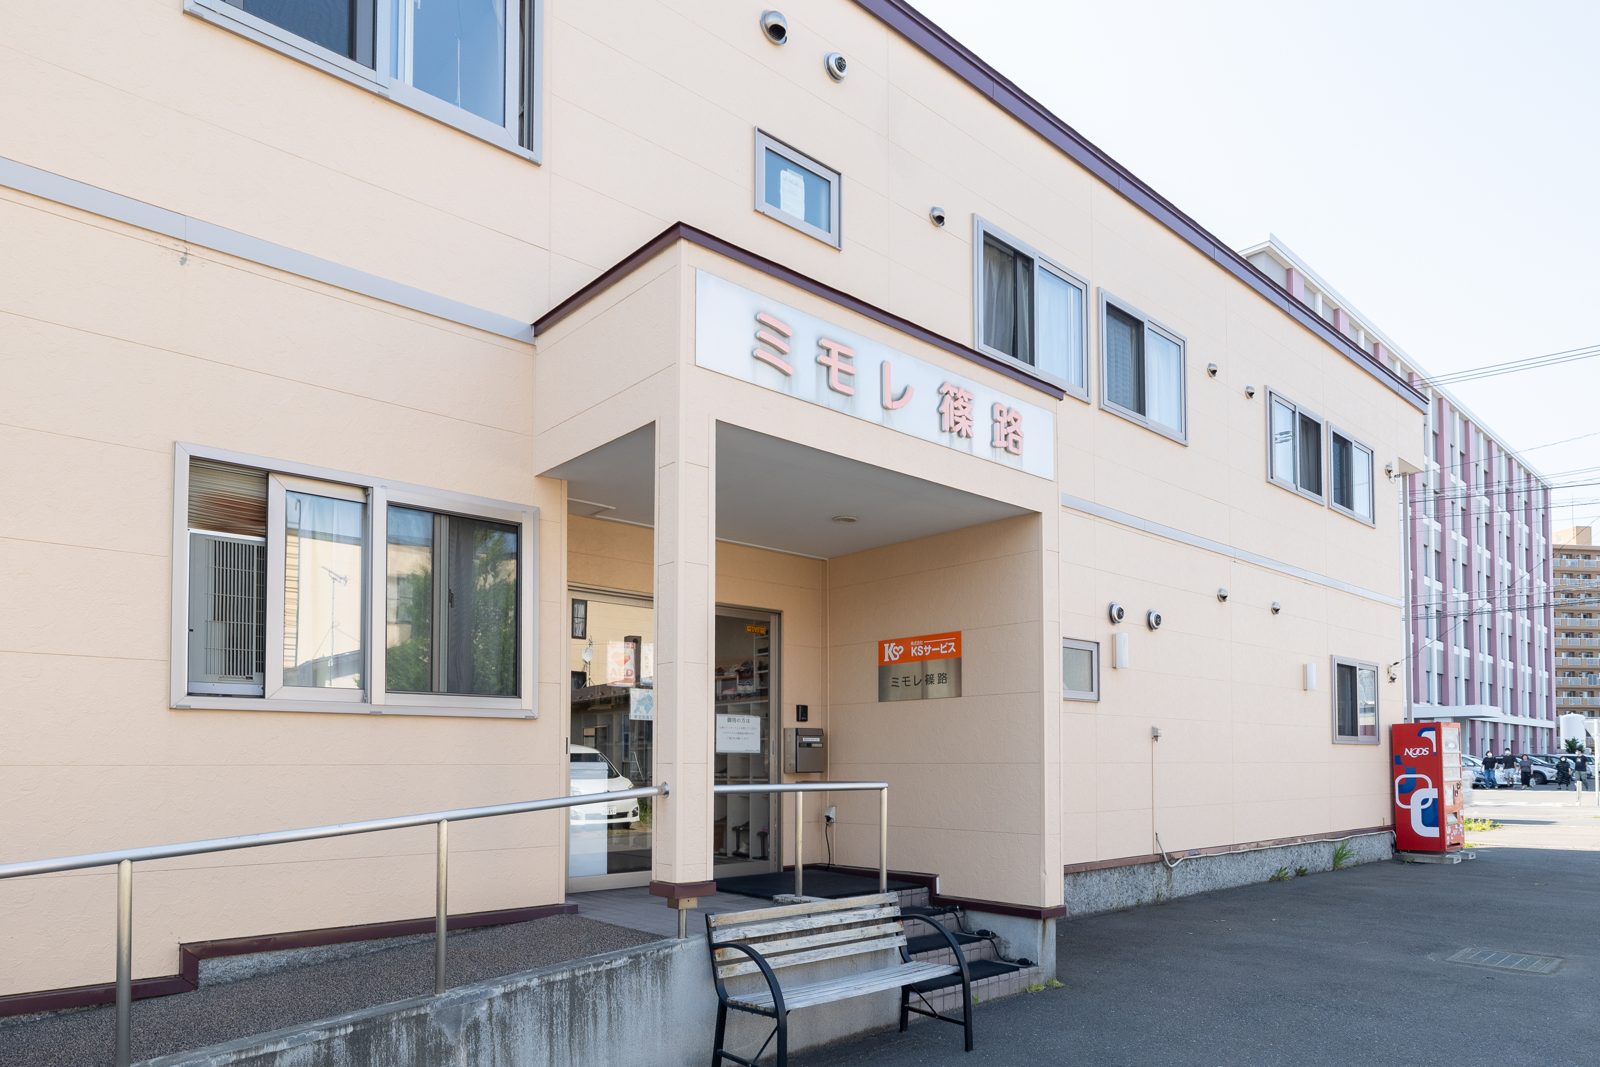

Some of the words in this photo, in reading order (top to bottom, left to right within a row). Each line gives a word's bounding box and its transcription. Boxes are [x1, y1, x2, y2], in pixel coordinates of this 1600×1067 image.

[752, 311, 1025, 456] ミモレ篠路
[911, 642, 957, 657] KSサービス
[890, 672, 948, 688] ミモレ篠路
